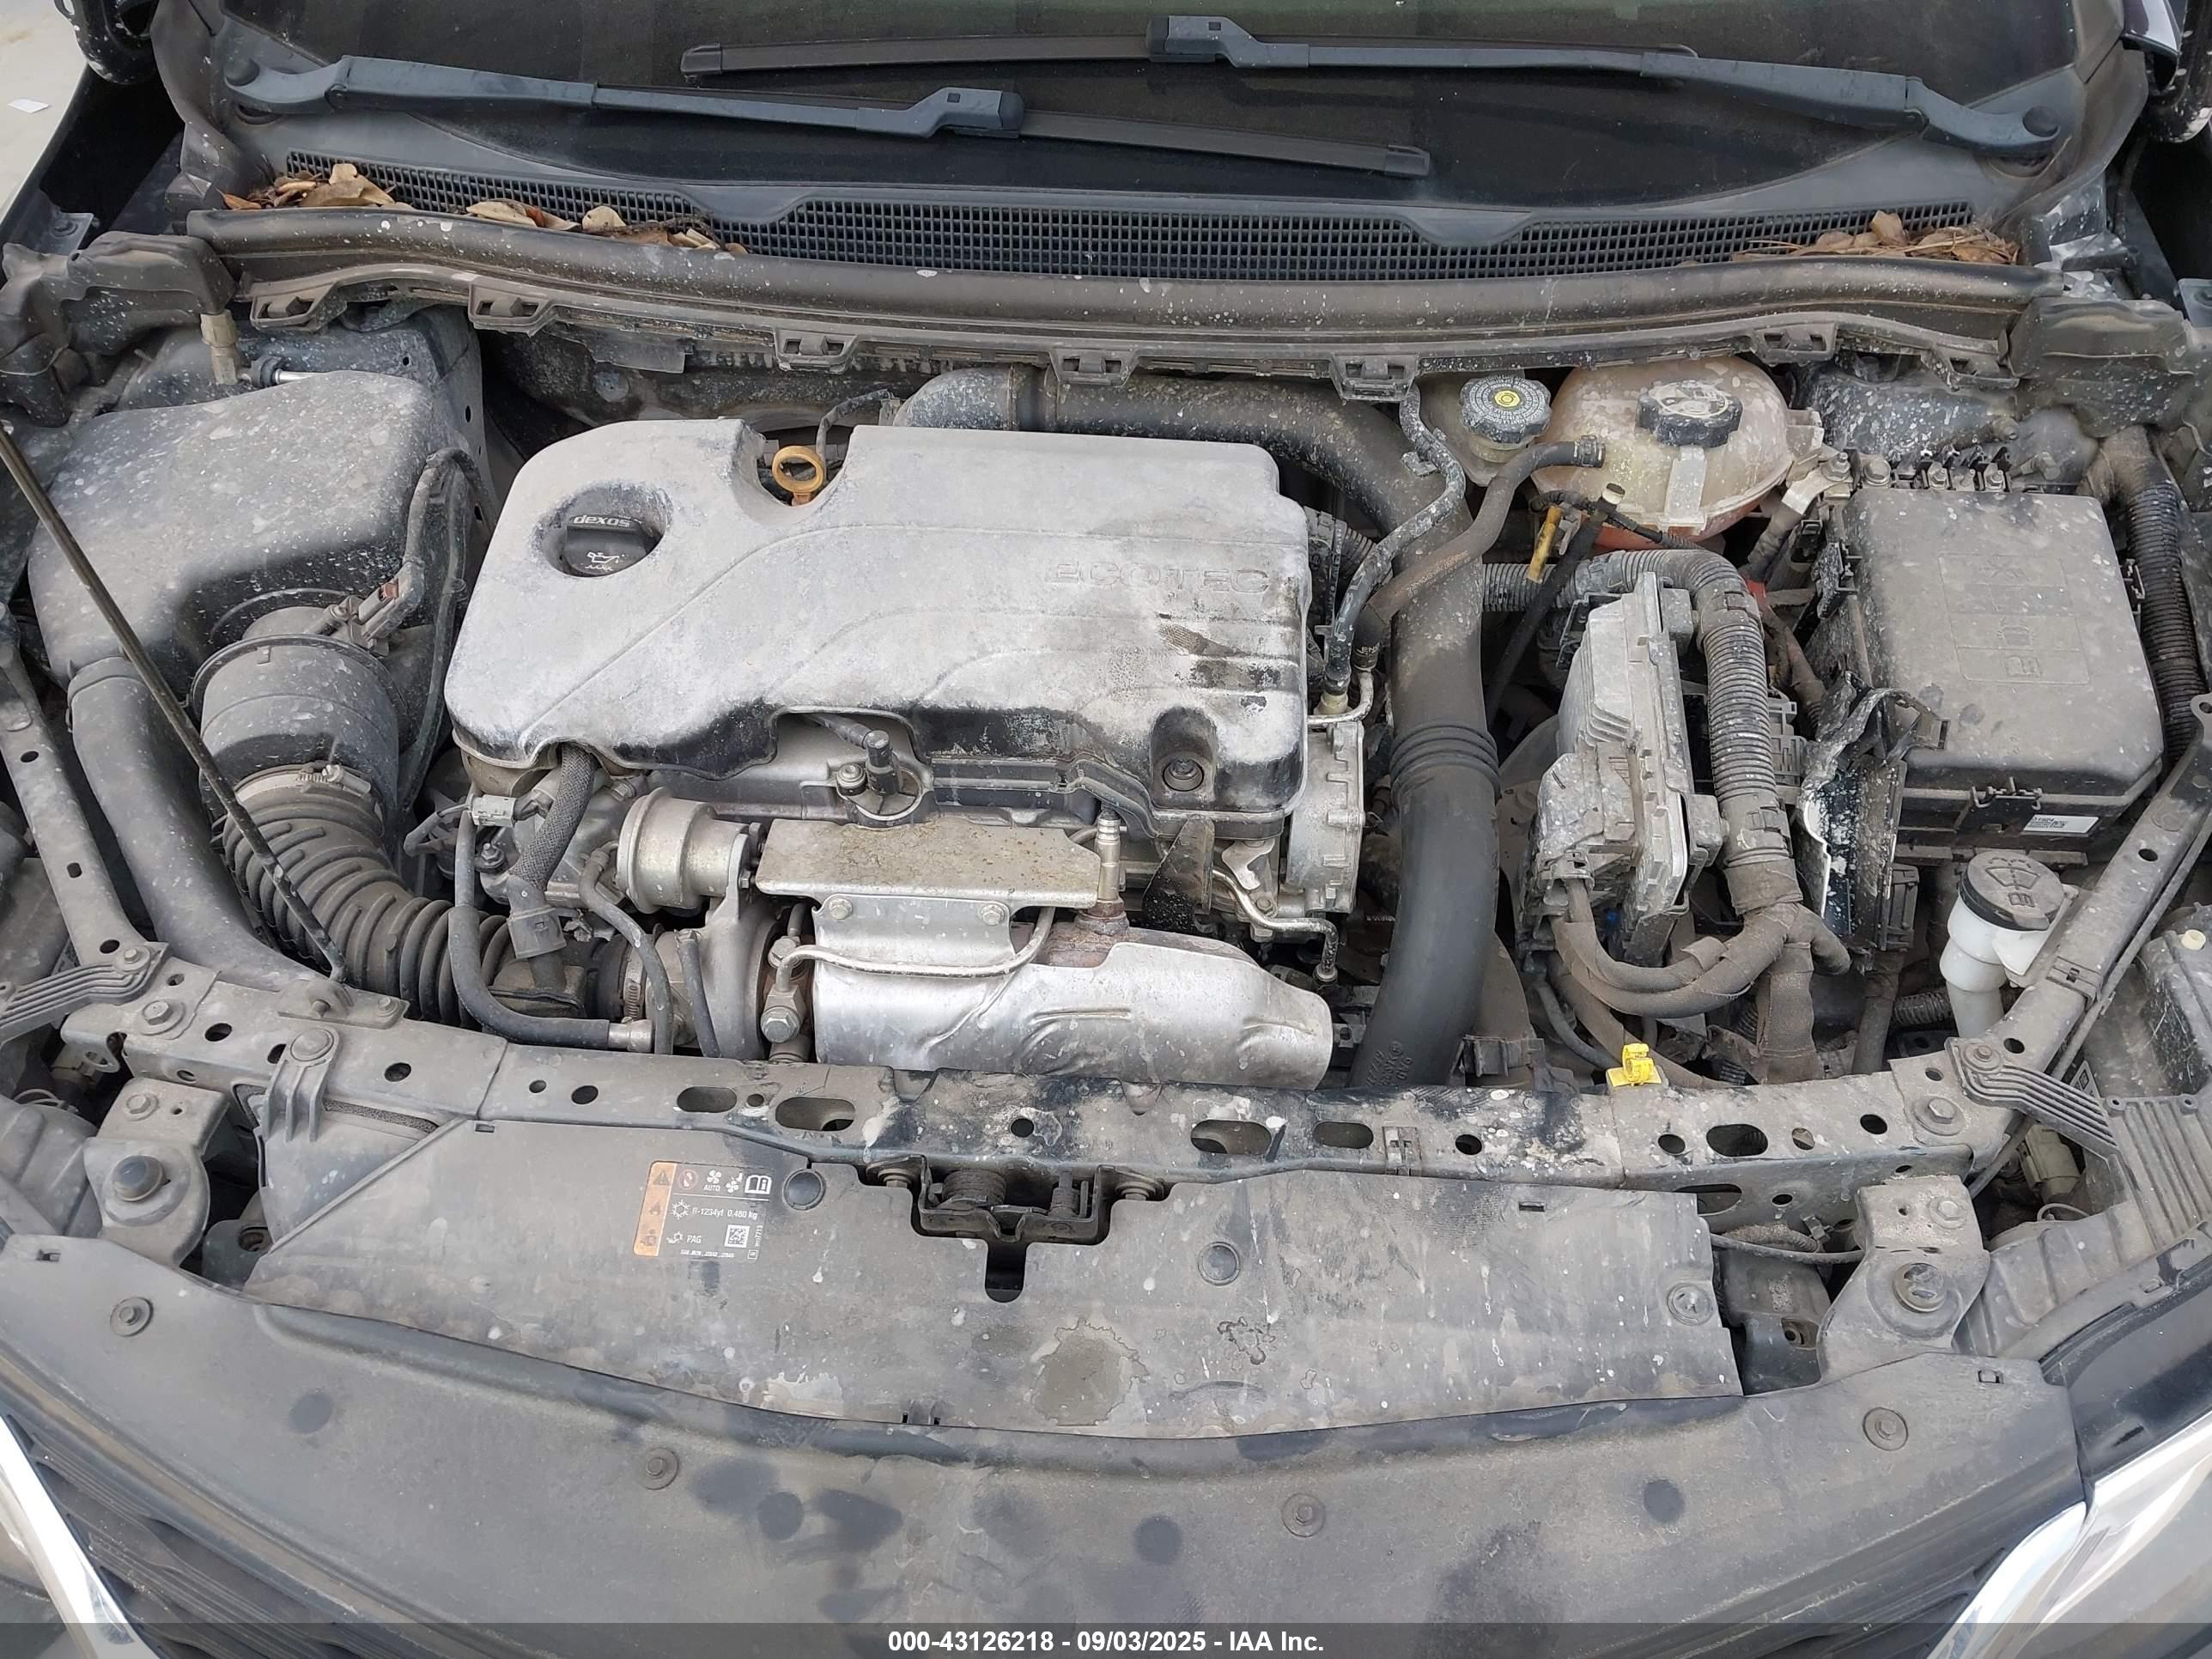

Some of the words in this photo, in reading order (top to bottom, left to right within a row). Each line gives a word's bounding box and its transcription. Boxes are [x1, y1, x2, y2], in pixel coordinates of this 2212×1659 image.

[573, 514, 631, 527] dexos
[1045, 559, 1269, 594] ECOTEC
[692, 1206, 725, 1218] R-1234yf
[726, 1209, 747, 1218] 0.480
[748, 1210, 758, 1220] kg
[686, 1234, 702, 1244] PAG
